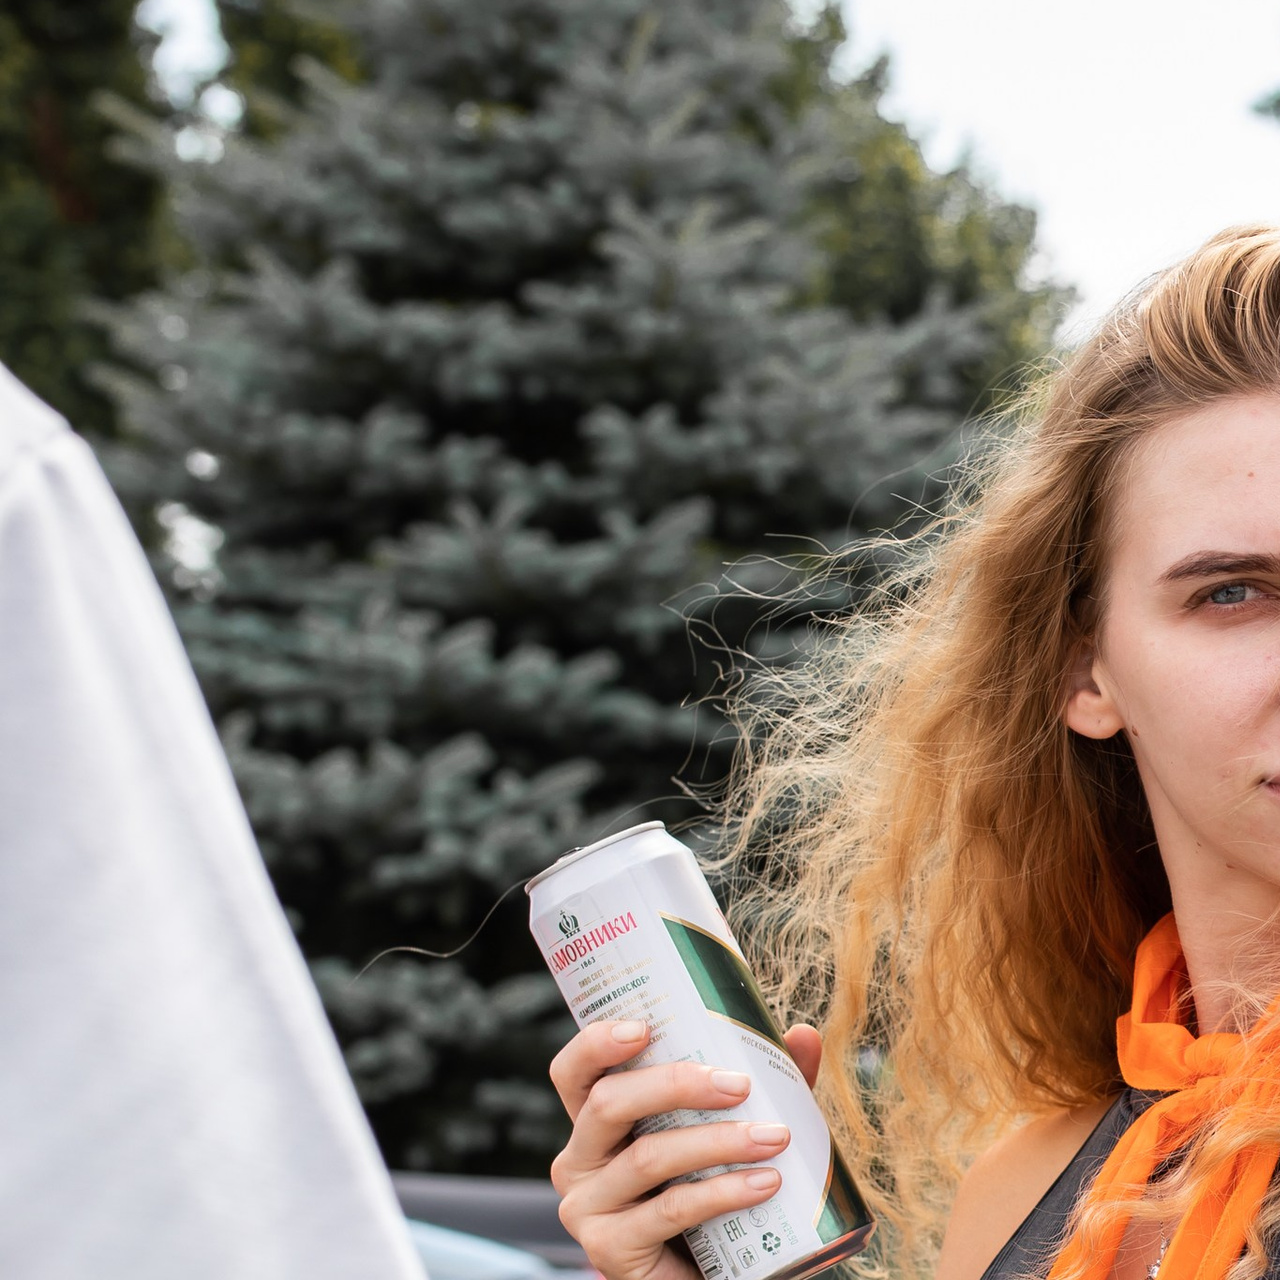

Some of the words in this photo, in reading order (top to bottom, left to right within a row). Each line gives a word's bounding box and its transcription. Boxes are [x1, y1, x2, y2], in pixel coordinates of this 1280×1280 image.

[549, 912, 638, 975] ХАМОВНИКИ
[580, 957, 596, 970] 1863
[578, 976, 592, 988] ПИВО
[740, 1034, 781, 1062] МОСКОВСКАЯ
[768, 1060, 799, 1083] КОМПАНИЯ
